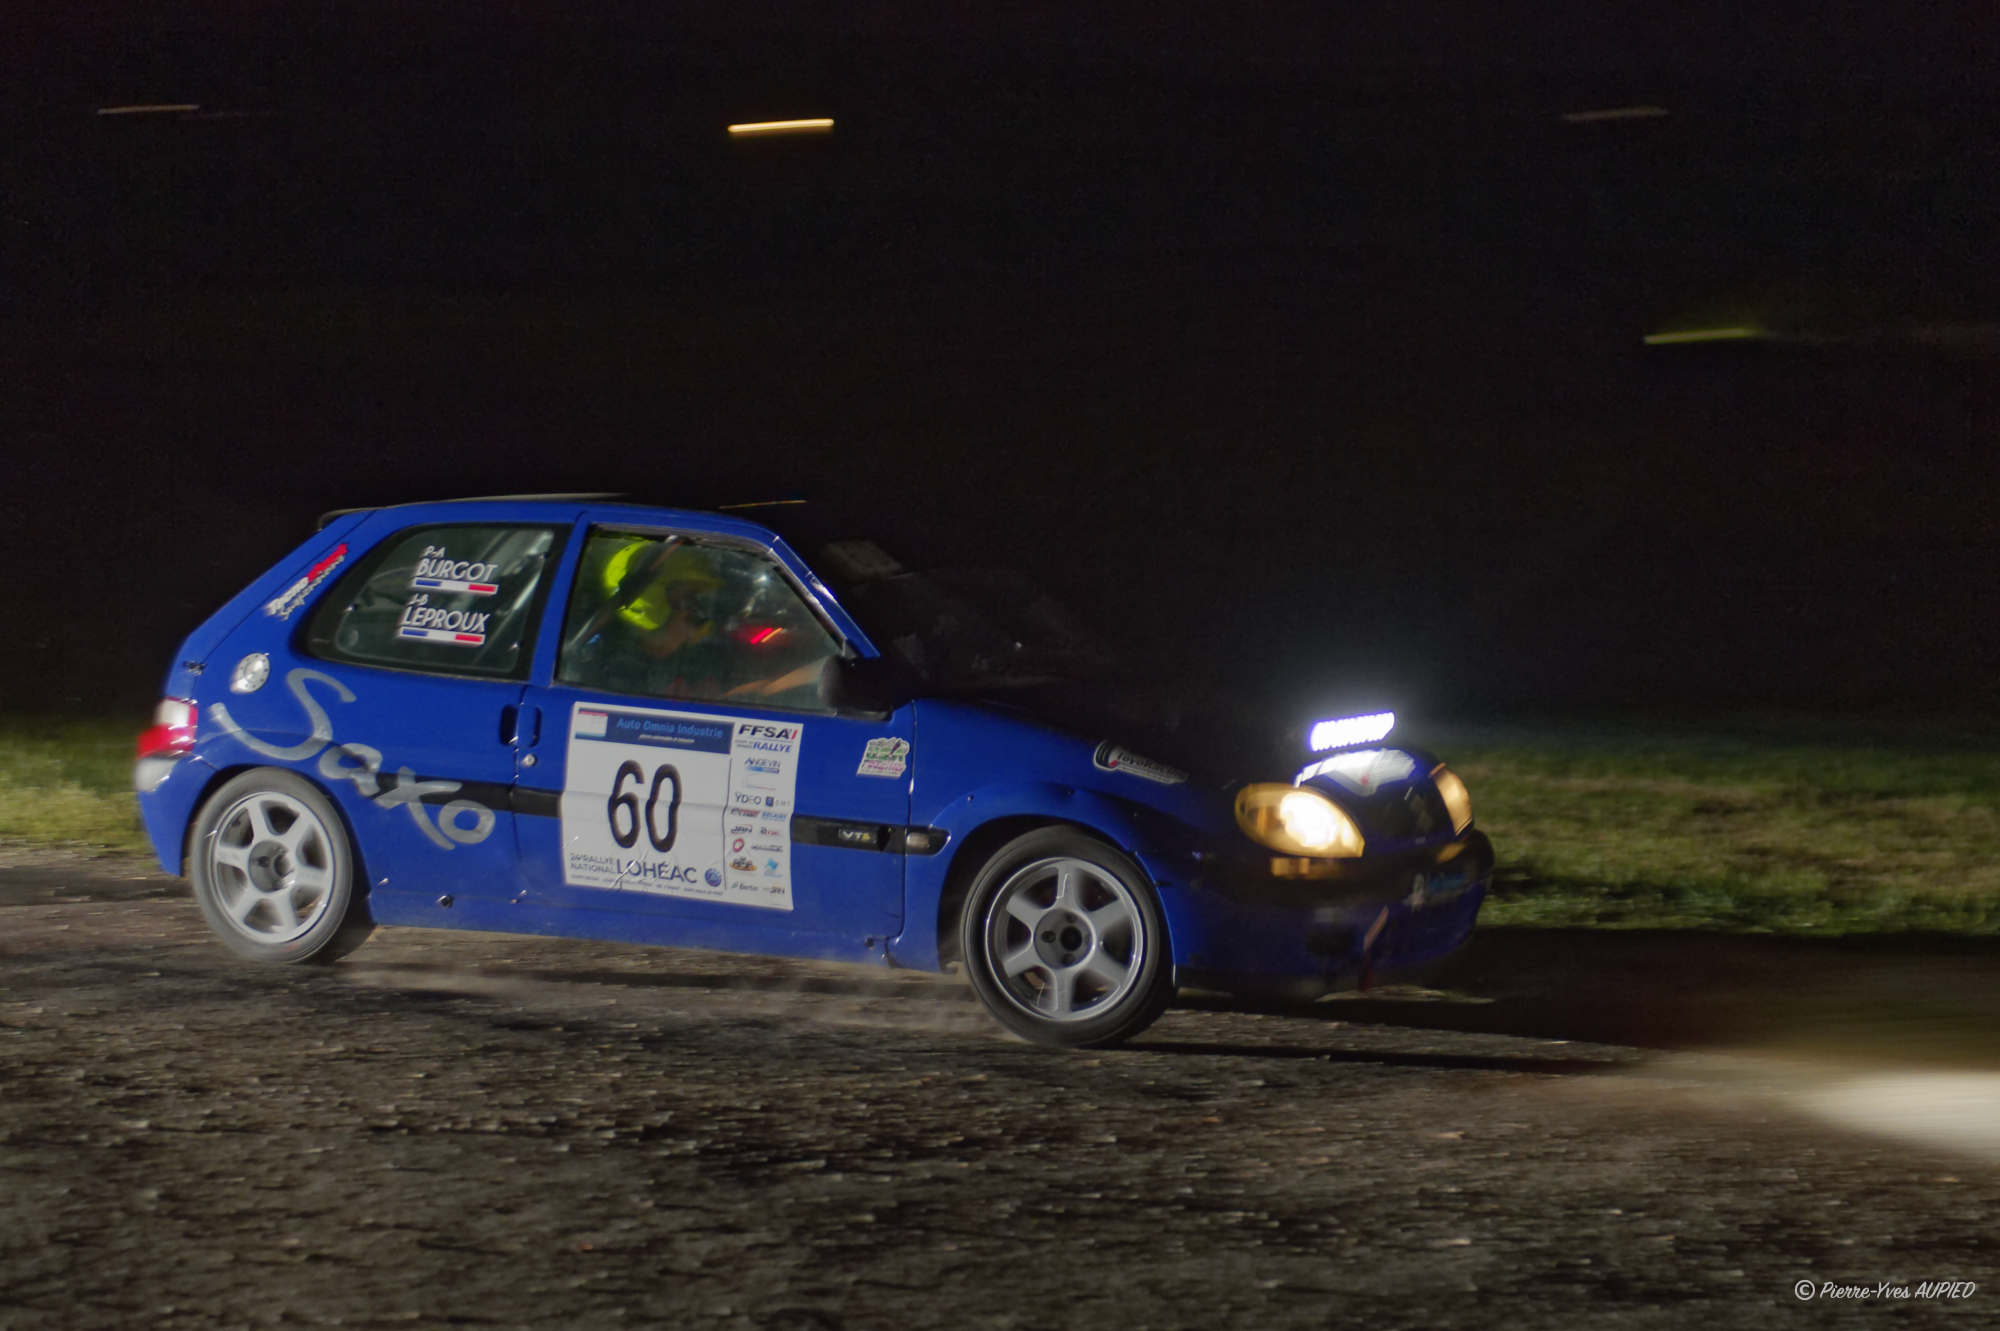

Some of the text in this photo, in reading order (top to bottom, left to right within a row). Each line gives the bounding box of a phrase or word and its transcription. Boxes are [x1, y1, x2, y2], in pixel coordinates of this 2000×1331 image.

[401, 606, 490, 632] LEPROUX
[616, 717, 724, 738] Auto Omnia Industrie
[738, 723, 789, 740] FFSA
[208, 667, 496, 850] Saxo
[753, 741, 793, 753] RALLYE
[608, 759, 682, 853] 60
[616, 858, 698, 884] LOHÉAC
